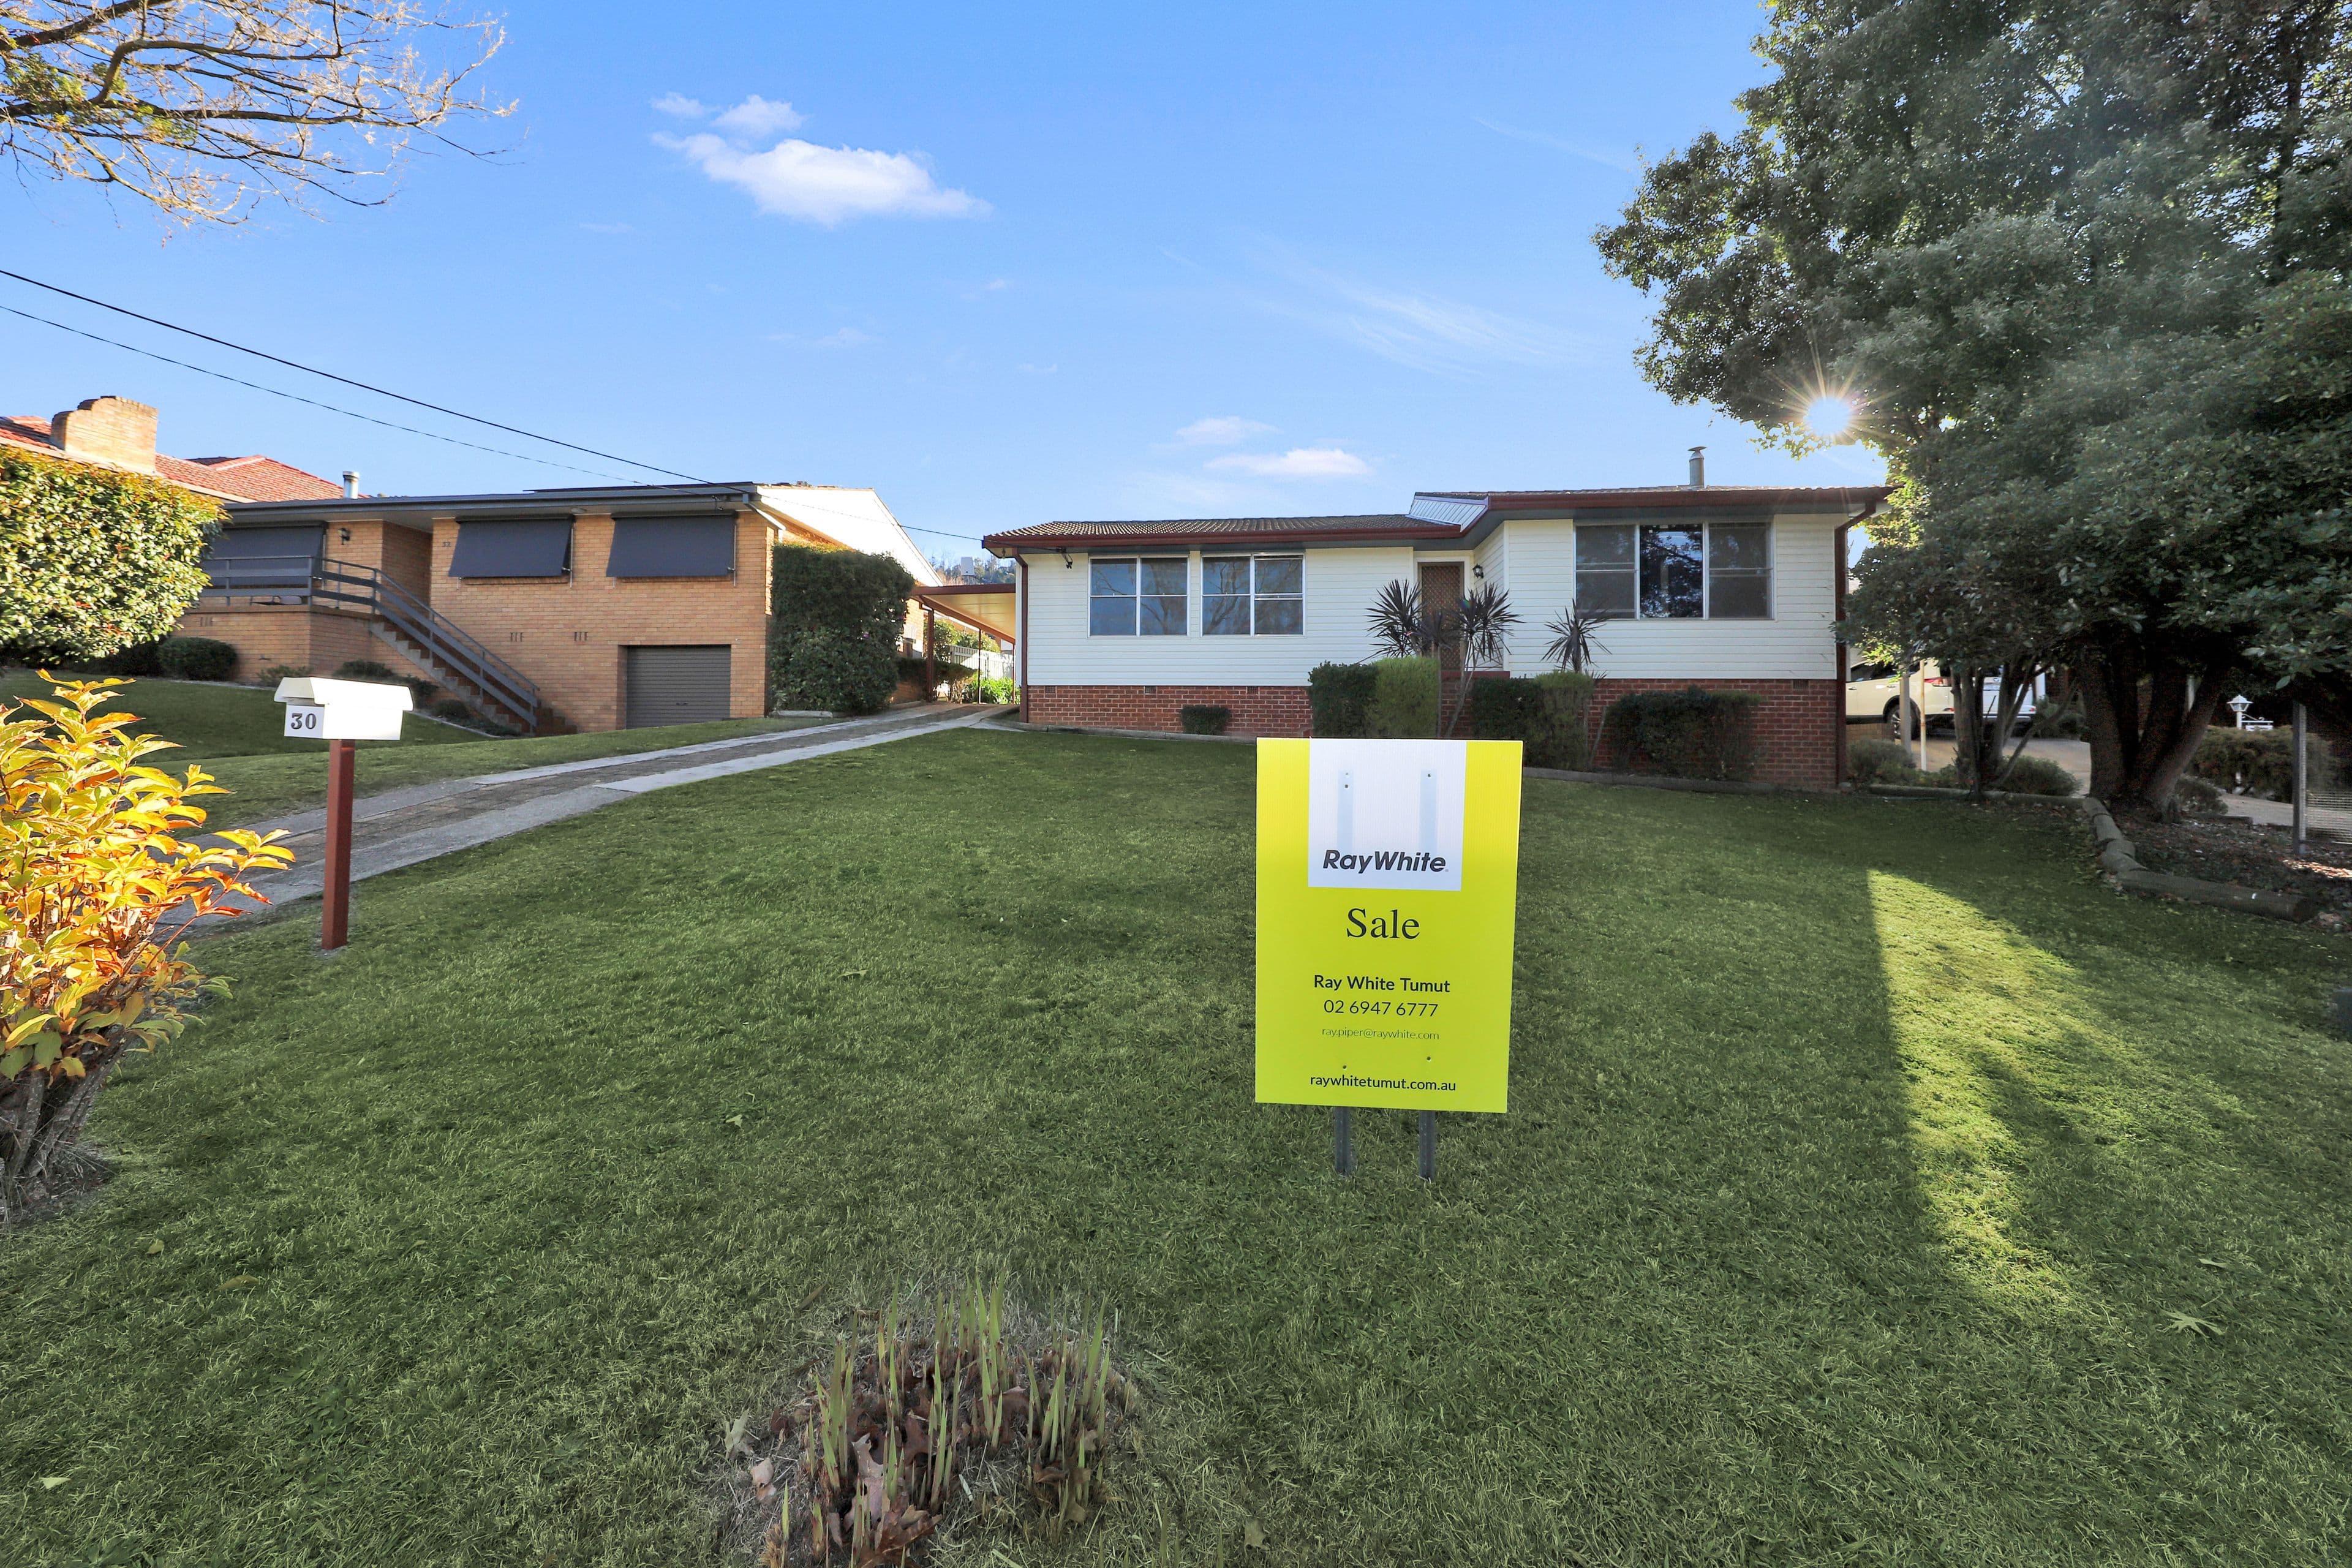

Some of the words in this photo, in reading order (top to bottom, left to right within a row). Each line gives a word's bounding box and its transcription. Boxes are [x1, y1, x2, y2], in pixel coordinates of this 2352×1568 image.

[291, 713, 317, 729] 30
[1323, 850, 1446, 874] RayWhite
[1346, 908, 1420, 940] Sale
[1314, 974, 1342, 991] Ray
[1347, 976, 1395, 991] White
[1400, 978, 1450, 993] Tumut
[1324, 1000, 1344, 1014] 02
[1349, 1001, 1392, 1016] 6947
[1396, 1002, 1439, 1017] 6777
[1322, 1027, 1439, 1039] ray.piper@raywhite.com
[1310, 1074, 1456, 1091] raywhitetumut.com.au
